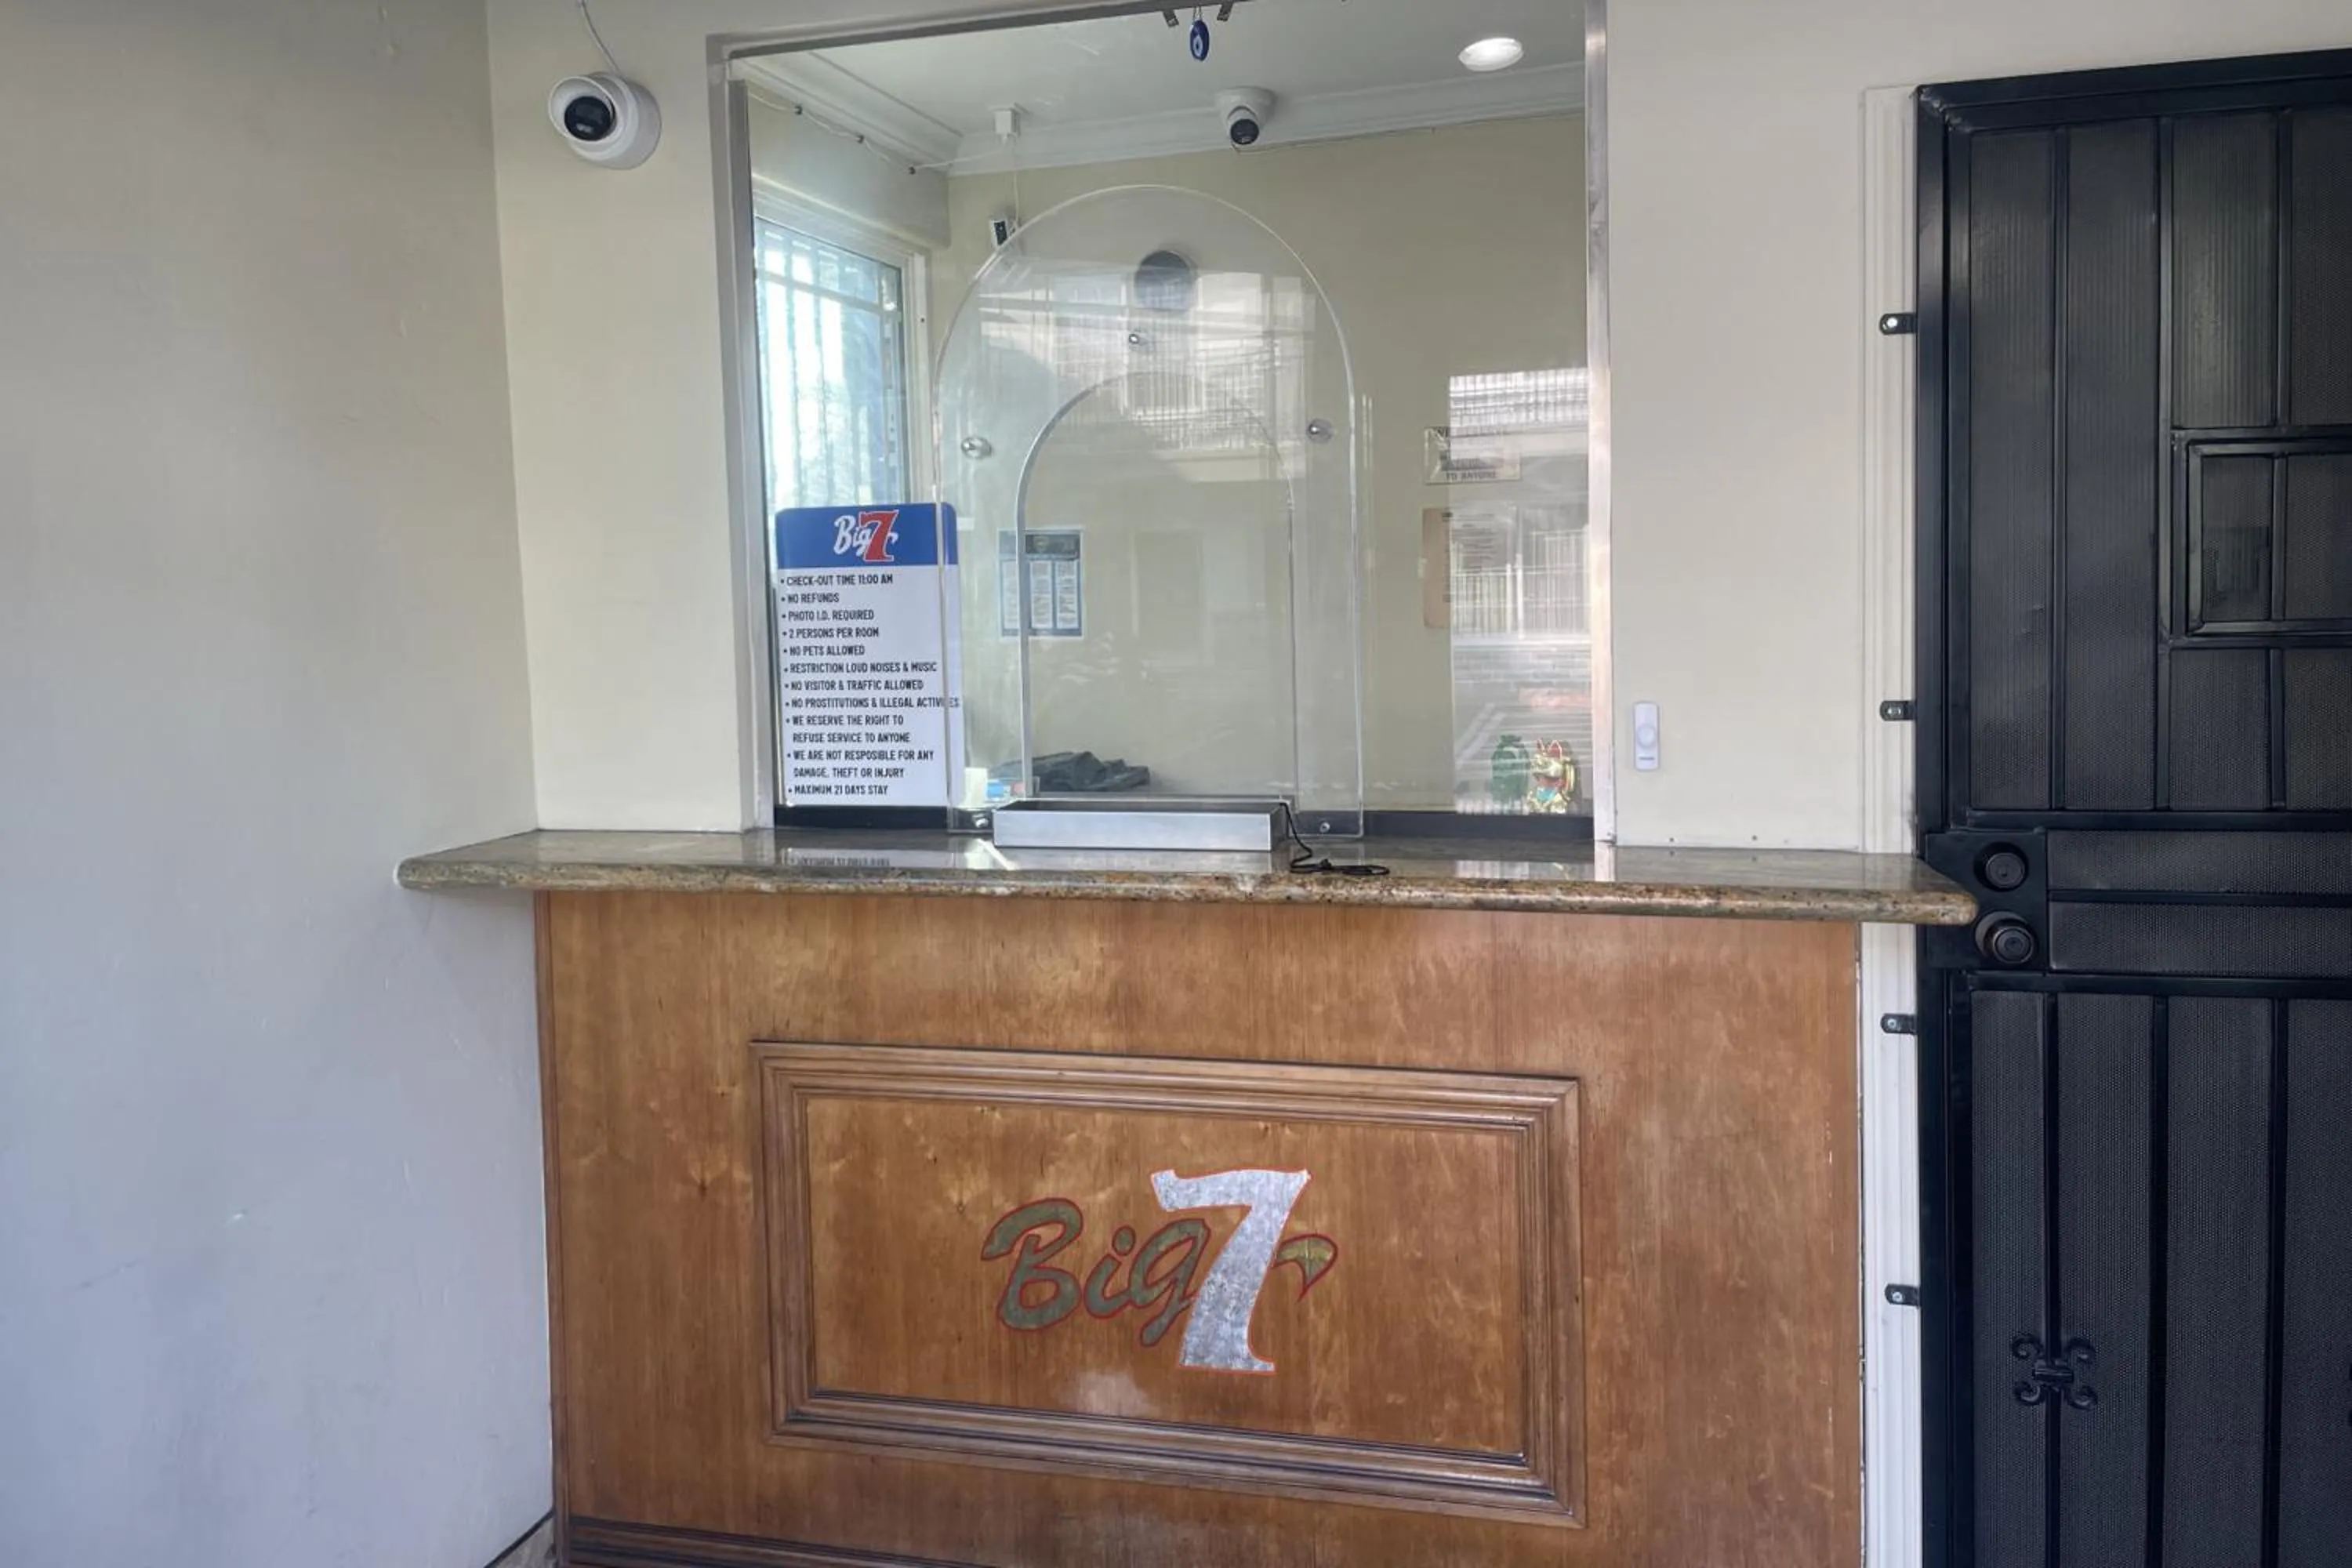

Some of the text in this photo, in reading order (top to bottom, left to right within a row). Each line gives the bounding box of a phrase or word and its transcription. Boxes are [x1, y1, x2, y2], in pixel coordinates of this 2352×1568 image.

[786, 574, 893, 586] CHECK-OUT TIME 11:00 AM
[788, 593, 839, 604] NO REFUNDS
[788, 610, 874, 621] PHOTO I.D. REQUIRED
[789, 627, 879, 638] 2 PERSONS PER ROOM
[790, 645, 865, 655] NO PETS ALLOWED
[790, 662, 937, 673] RESTRICTION LOUD NOISES & MUSIC
[791, 680, 923, 691] NO VISITOR & TRAFFIC ALLOWED
[792, 698, 803, 708] NO
[805, 698, 869, 708] PROSTITUTIONS
[872, 698, 877, 707] &
[880, 698, 913, 707] ILLEGAL
[793, 715, 903, 725] WE RESERVE THE RIGHT TO
[793, 732, 910, 742] REFUSE SERVICE TO ANYONE
[793, 750, 805, 760] WE
[808, 750, 824, 760] ARE
[826, 750, 842, 760] NOT
[898, 750, 915, 760] FOR
[917, 750, 934, 760] ANY
[833, 768, 858, 778] THEFT
[861, 768, 872, 778] OR
[874, 768, 904, 777] INJURY
[795, 785, 888, 795] MAXIMUM 21 DAYS STAY
